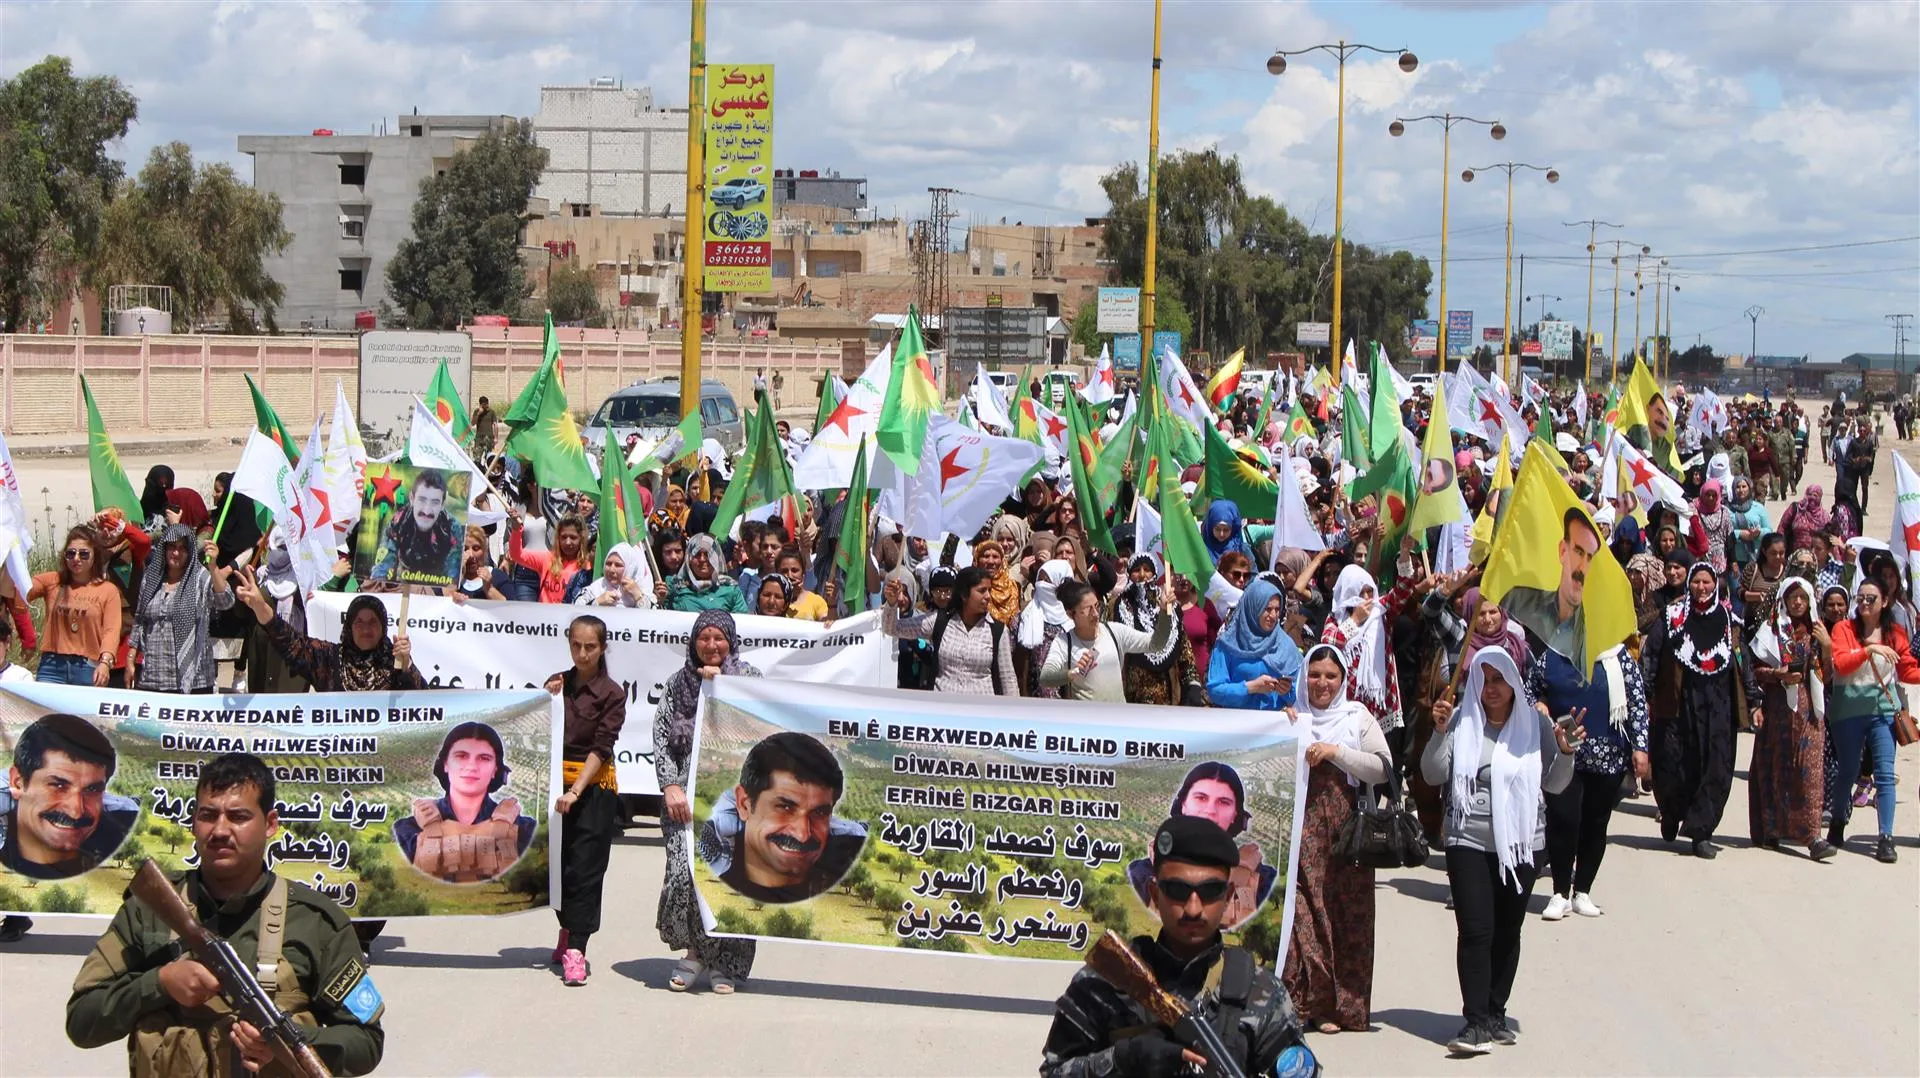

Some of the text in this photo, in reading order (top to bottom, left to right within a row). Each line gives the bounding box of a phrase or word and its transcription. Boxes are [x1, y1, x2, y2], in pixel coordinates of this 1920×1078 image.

[719, 67, 765, 89] مركز
[712, 91, 769, 118] عيسى
[711, 121, 743, 133] كهرباء
[753, 120, 770, 133] زينة
[740, 138, 765, 148] جميع
[720, 150, 760, 163] السيارات
[709, 256, 767, 264] 0933103196
[716, 245, 762, 255] 366124
[1, 462, 17, 492] PYD
[472, 621, 558, 637] navdewltî
[638, 629, 690, 645] Efrînê
[822, 633, 865, 648] dikin
[99, 702, 130, 718] EM
[137, 702, 150, 719] Ê
[157, 704, 304, 724] BERXWEDANÊ
[162, 734, 246, 753] DÎWARA
[828, 719, 860, 739] EM
[866, 718, 881, 739] Ê
[887, 724, 1038, 751] BERXWEDANÊ
[158, 761, 200, 779] EFR
[273, 766, 320, 783] GAR
[893, 754, 980, 779] DÎWARA
[886, 786, 965, 809] EFRÎNÊ
[274, 789, 387, 829] سوف نصع
[267, 831, 349, 870] ونحطم
[880, 813, 1123, 868] سوف نصعد المقاومة
[297, 873, 358, 906] وسن
[913, 863, 1083, 909] ونحطم السور
[895, 899, 1089, 950] وسنحرر عفرين
